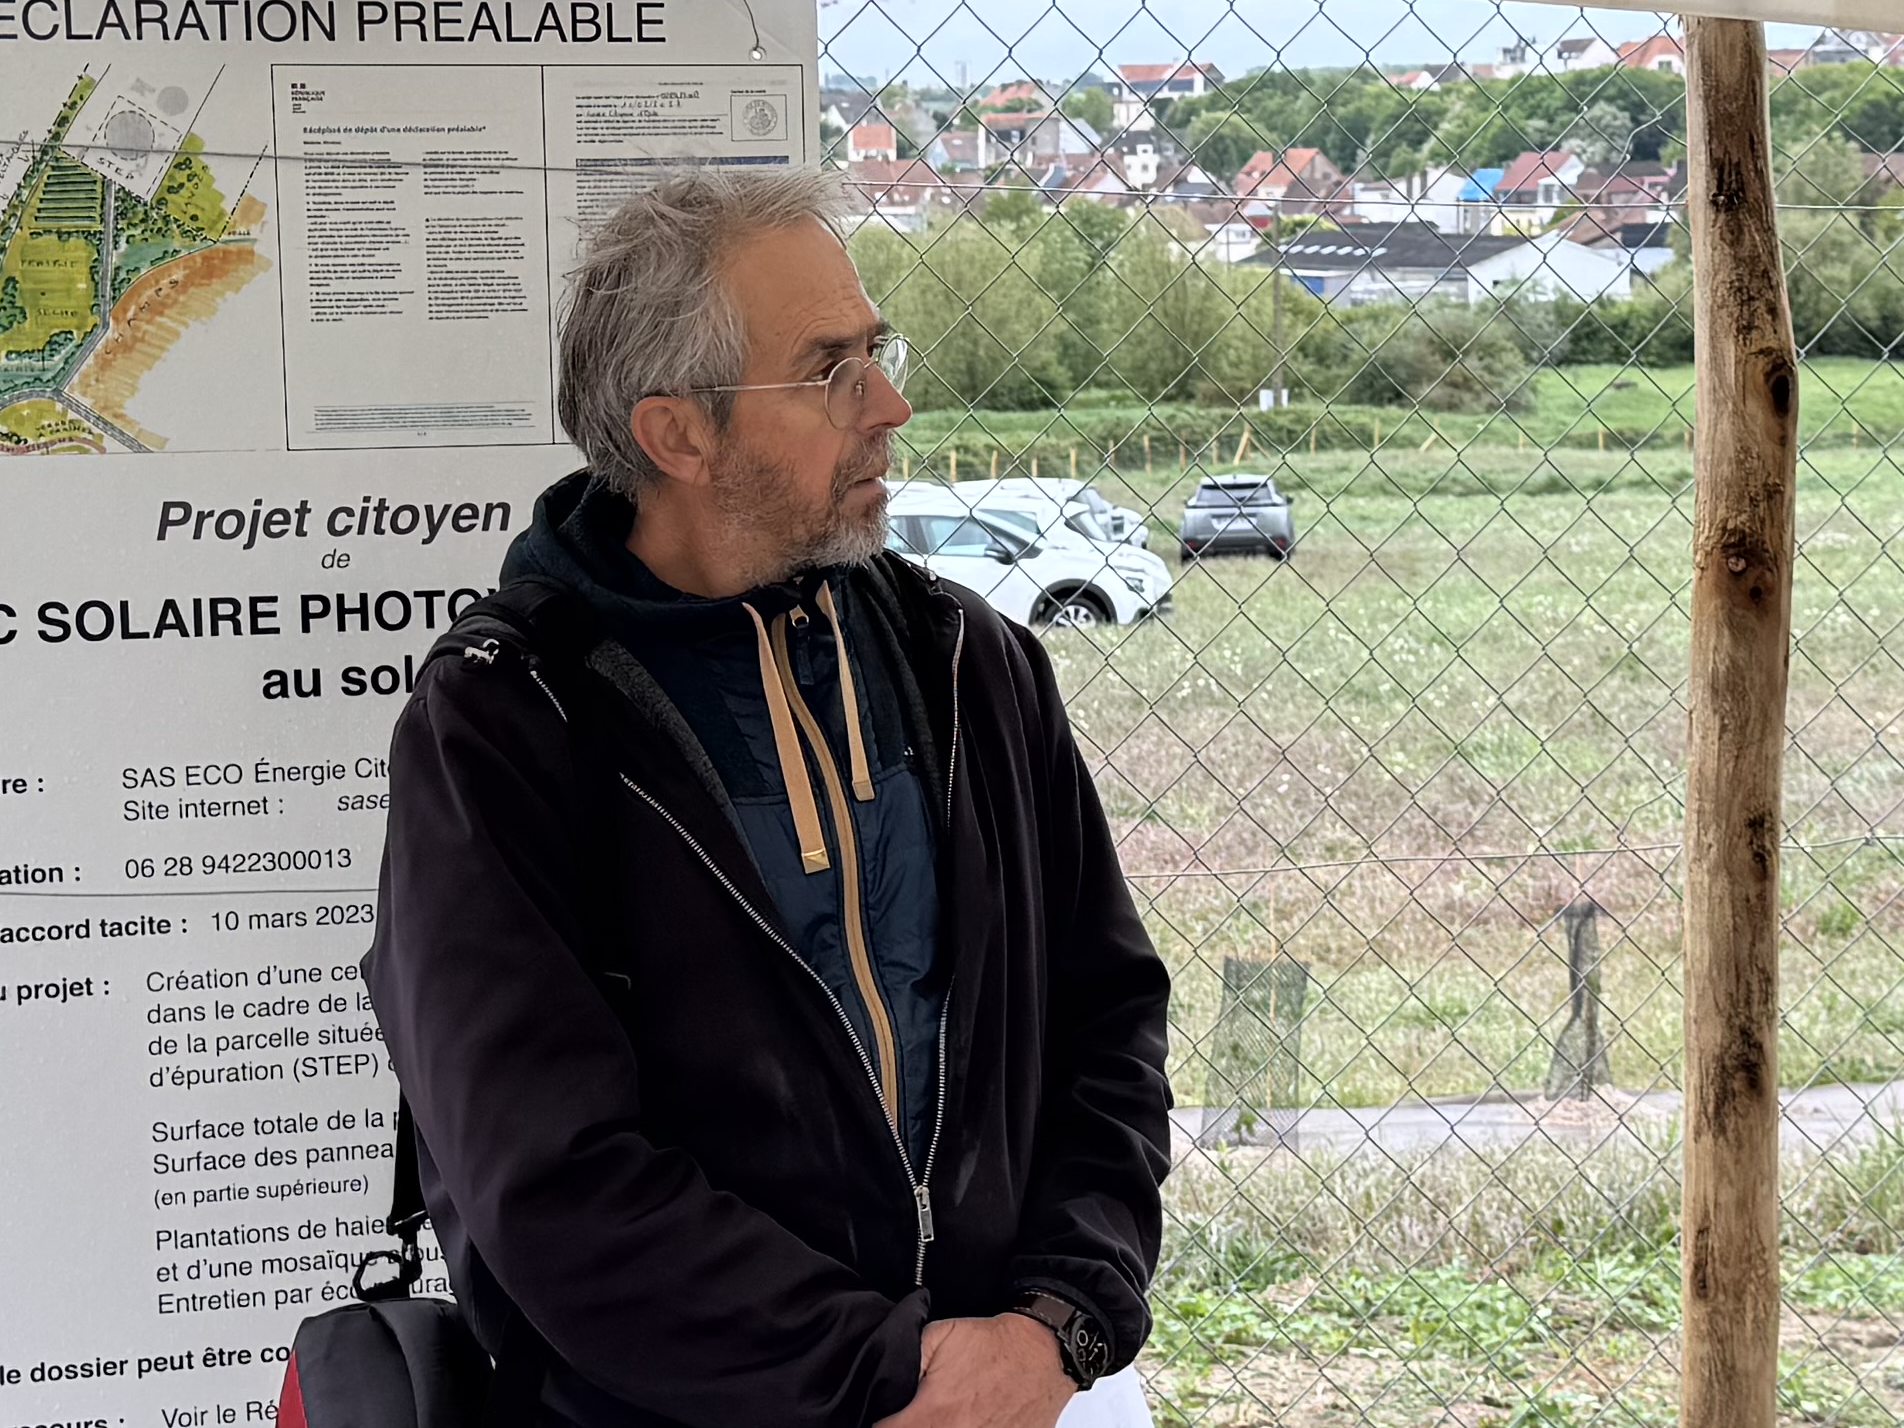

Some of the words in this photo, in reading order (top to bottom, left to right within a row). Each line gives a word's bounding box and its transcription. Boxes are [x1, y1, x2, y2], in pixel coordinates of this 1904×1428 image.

[357, 0, 667, 43] PREALABLE
[156, 498, 312, 550] Projet
[326, 496, 511, 544] citoyen
[321, 548, 351, 570] de
[37, 595, 281, 644] SOLAIRE
[300, 587, 497, 634] PHOTO
[262, 667, 322, 700] au
[122, 766, 176, 790] SAS
[185, 763, 243, 787] ECO
[254, 757, 346, 786] Énergie
[354, 756, 390, 779] Cit
[123, 799, 170, 822] Site
[178, 795, 269, 819] internet
[125, 858, 155, 879] 06
[164, 856, 193, 877] 28
[201, 848, 352, 875] 9422300013
[99, 915, 172, 938] tacite
[211, 910, 240, 932] 10
[248, 911, 308, 930] mars
[315, 903, 375, 926] 2023
[16, 977, 94, 1006] projet
[146, 968, 249, 993] Création
[257, 964, 322, 986] d'une
[330, 964, 364, 982] ce
[147, 1003, 206, 1025] dans
[215, 1000, 235, 1020] le
[243, 995, 310, 1019] cadre
[318, 993, 347, 1014] de
[356, 991, 372, 1012] la
[148, 1035, 178, 1056] de
[187, 1033, 208, 1054] la
[216, 1026, 310, 1063] parcelle
[318, 1021, 385, 1045] située
[149, 1062, 284, 1090] d'épuration
[293, 1052, 379, 1083] (STEP)
[152, 1119, 245, 1143] Surface
[253, 1112, 319, 1136] totale
[326, 1109, 356, 1131] de
[365, 1107, 385, 1129] la
[153, 1150, 246, 1175] Surface
[254, 1146, 298, 1168] des
[154, 1189, 186, 1210] (en
[193, 1184, 250, 1208] partie
[256, 1174, 369, 1202] supérieure)
[156, 1224, 290, 1251] Plantations
[297, 1219, 327, 1240] de
[335, 1215, 387, 1238] haie
[156, 1262, 179, 1283] et
[186, 1258, 253, 1281] d'une
[158, 1288, 266, 1315] Entretien
[274, 1287, 313, 1311] par
[0, 1365, 22, 1386] le
[30, 1357, 129, 1383] dossier
[137, 1350, 195, 1380] peut
[202, 1346, 252, 1368] être
[161, 1407, 209, 1428] Voir
[216, 1404, 237, 1425] le
